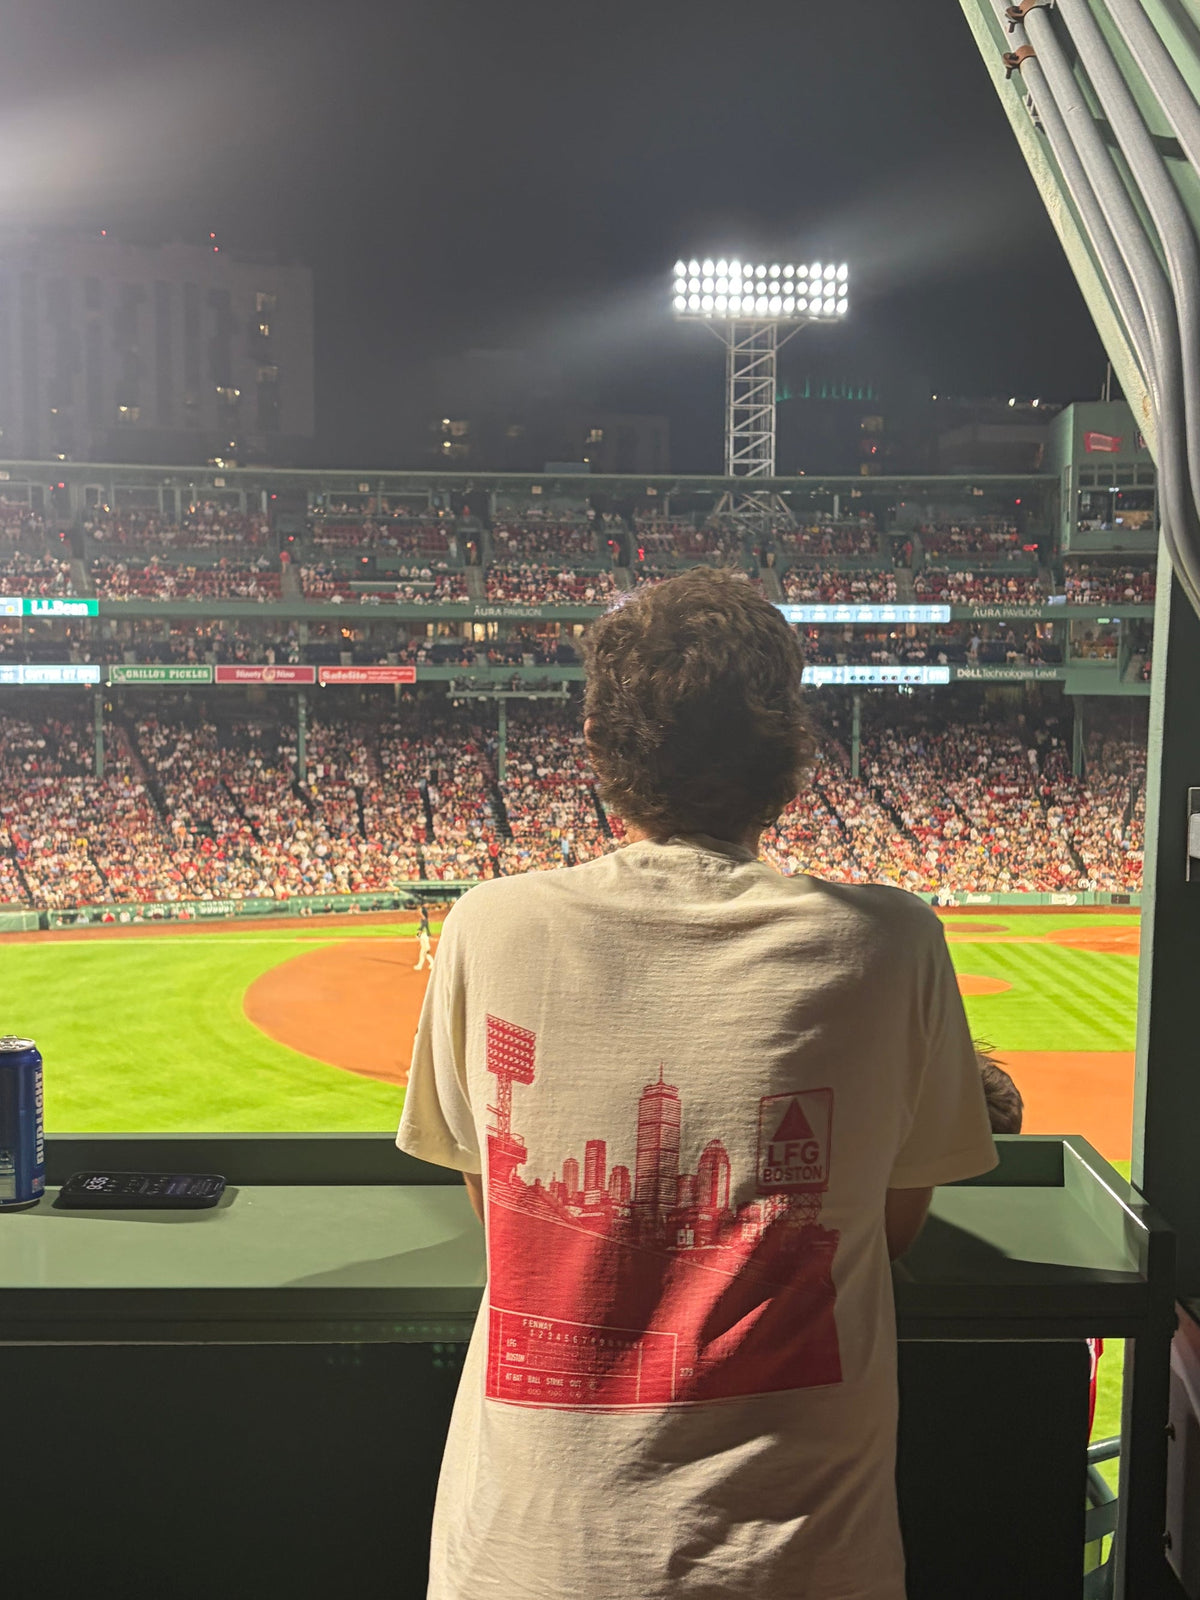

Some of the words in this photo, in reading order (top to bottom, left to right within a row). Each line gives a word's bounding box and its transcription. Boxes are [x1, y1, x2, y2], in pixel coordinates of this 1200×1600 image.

[503, 607, 543, 617] PAVILION
[1002, 607, 1042, 617] PAVILION
[169, 669, 208, 679] PICKLES
[236, 669, 261, 679] Ninety
[276, 670, 296, 679] Nine
[982, 668, 1034, 680] Technologies
[1035, 669, 1057, 678] Level
[35, 1071, 43, 1124] LIGHT
[36, 1124, 44, 1165] BUD
[768, 1141, 820, 1167] LFG
[763, 1165, 823, 1183] BOSTON
[522, 1318, 554, 1331] FENWAY
[506, 1337, 518, 1348] LFG
[512, 1373, 523, 1382] BAT
[527, 1374, 541, 1385] BALL
[545, 1377, 564, 1387] STRIKE
[569, 1379, 582, 1388] OUT
